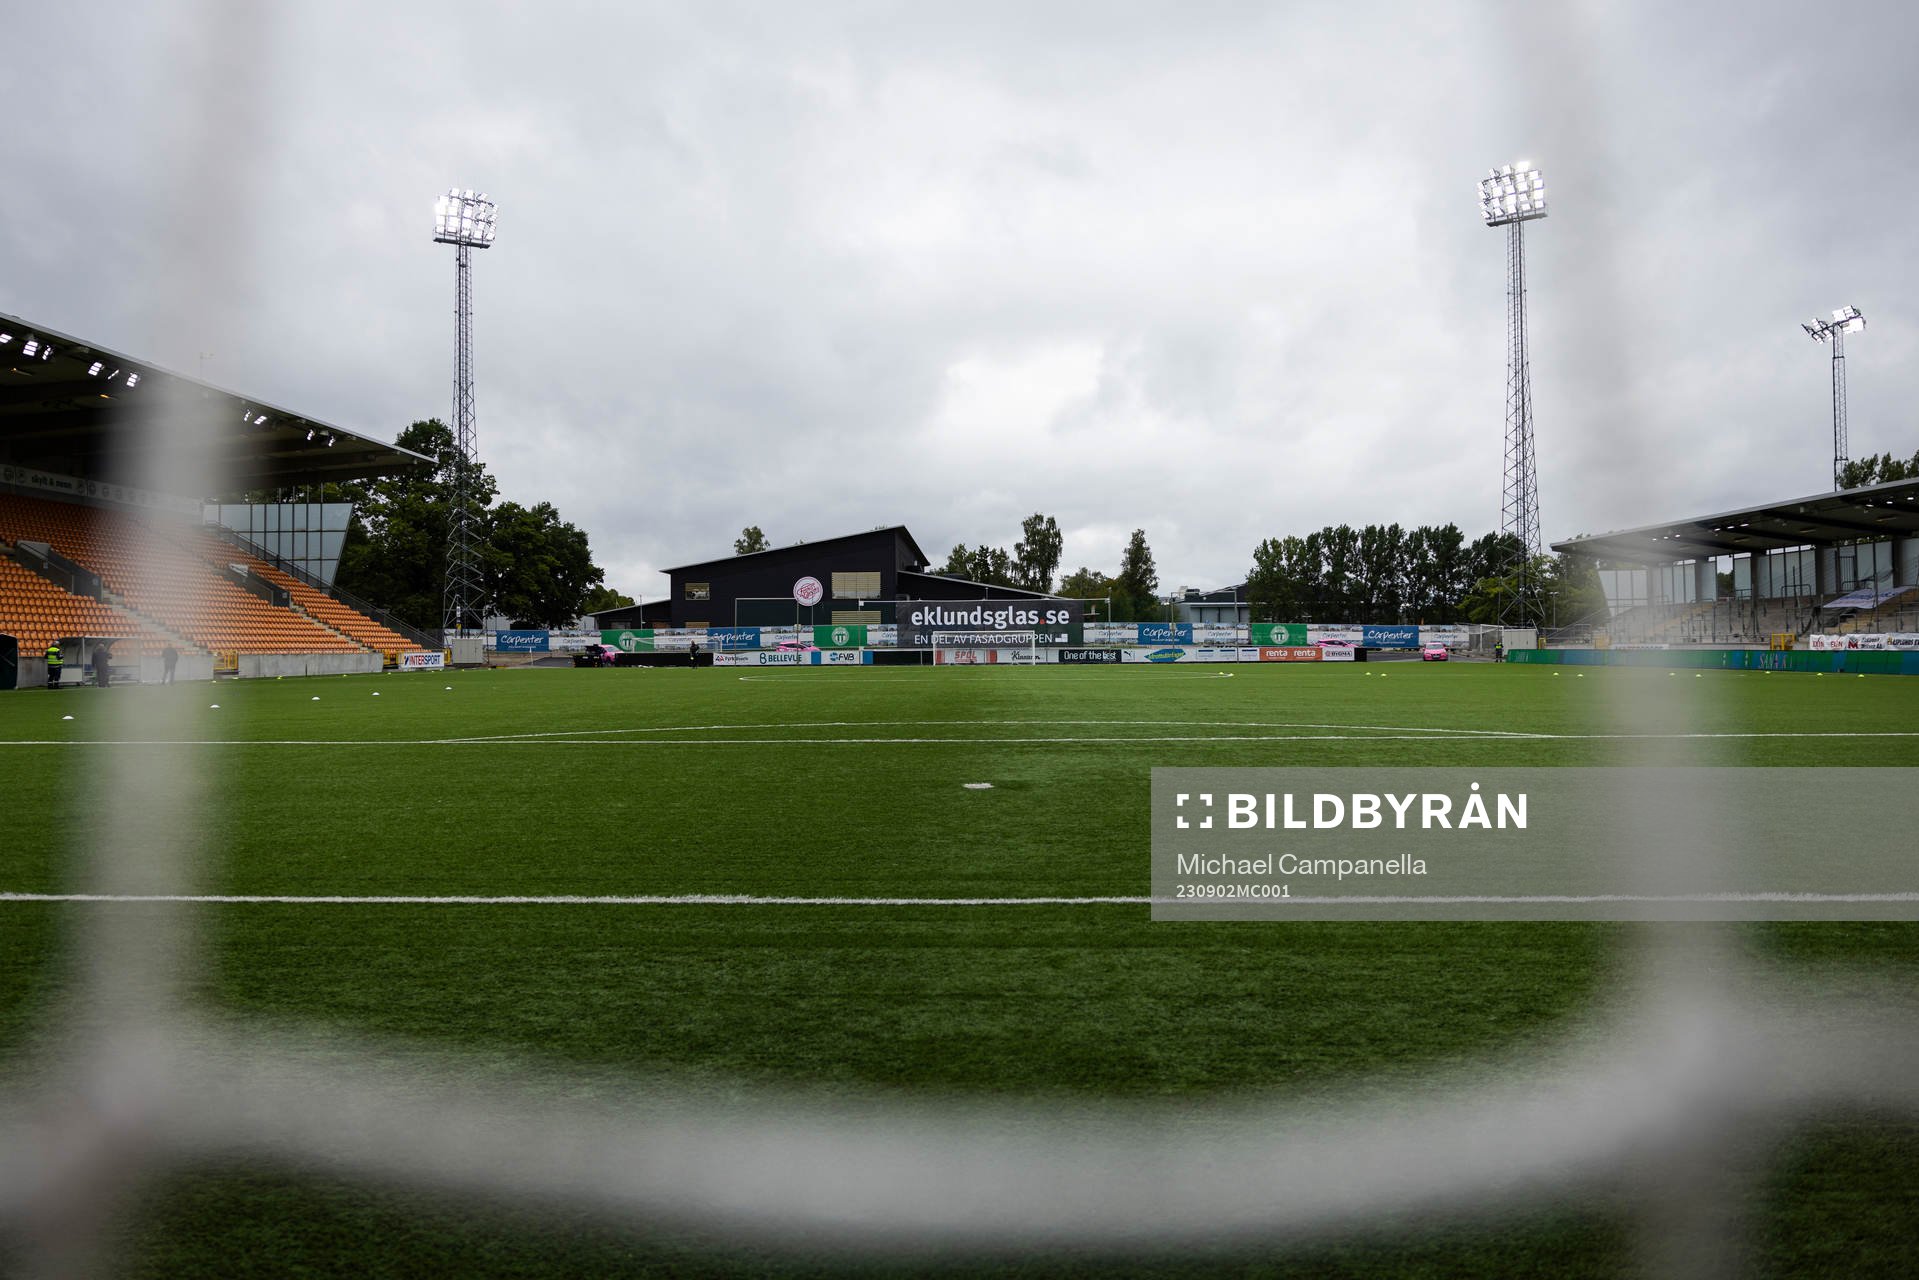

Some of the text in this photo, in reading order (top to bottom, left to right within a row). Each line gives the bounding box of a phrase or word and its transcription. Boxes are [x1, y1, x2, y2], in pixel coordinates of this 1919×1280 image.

[911, 605, 1070, 629] eklundsglas.se
[500, 634, 544, 646] Carpenter
[914, 633, 1053, 644] EN DEL AV FASADGRUPPEN
[1367, 630, 1414, 640] Carpenter
[768, 653, 803, 662] BELLEVUE
[838, 652, 855, 661] FVB
[1064, 651, 1078, 660] One
[1079, 651, 1087, 660] of
[1088, 651, 1101, 660] the
[1266, 649, 1316, 657] renta renta
[409, 655, 441, 666] INTERSPORT
